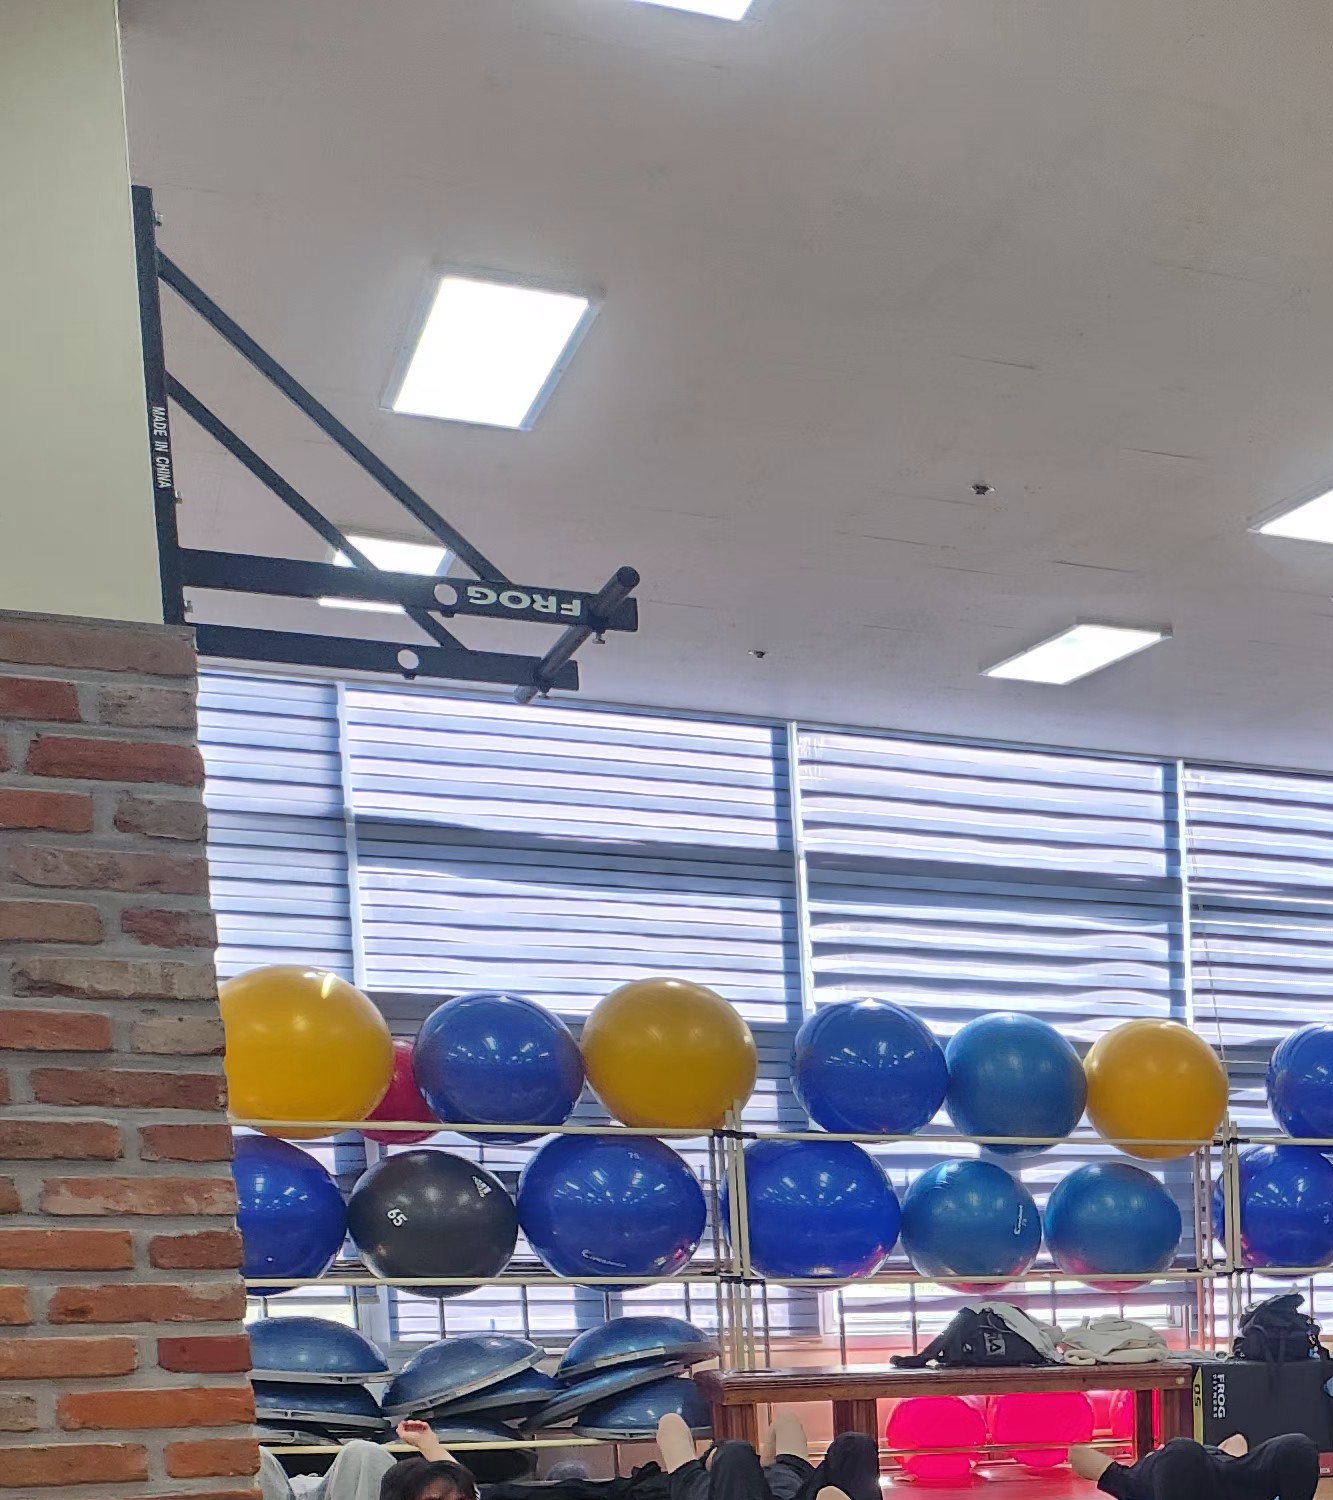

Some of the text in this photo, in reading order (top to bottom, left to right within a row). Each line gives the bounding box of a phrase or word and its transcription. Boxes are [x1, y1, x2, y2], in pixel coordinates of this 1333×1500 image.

[152, 406, 172, 489] MADE IN CHINA
[467, 585, 581, 617] FROG
[387, 1208, 409, 1227] 65
[1217, 1374, 1226, 1418] FROG
